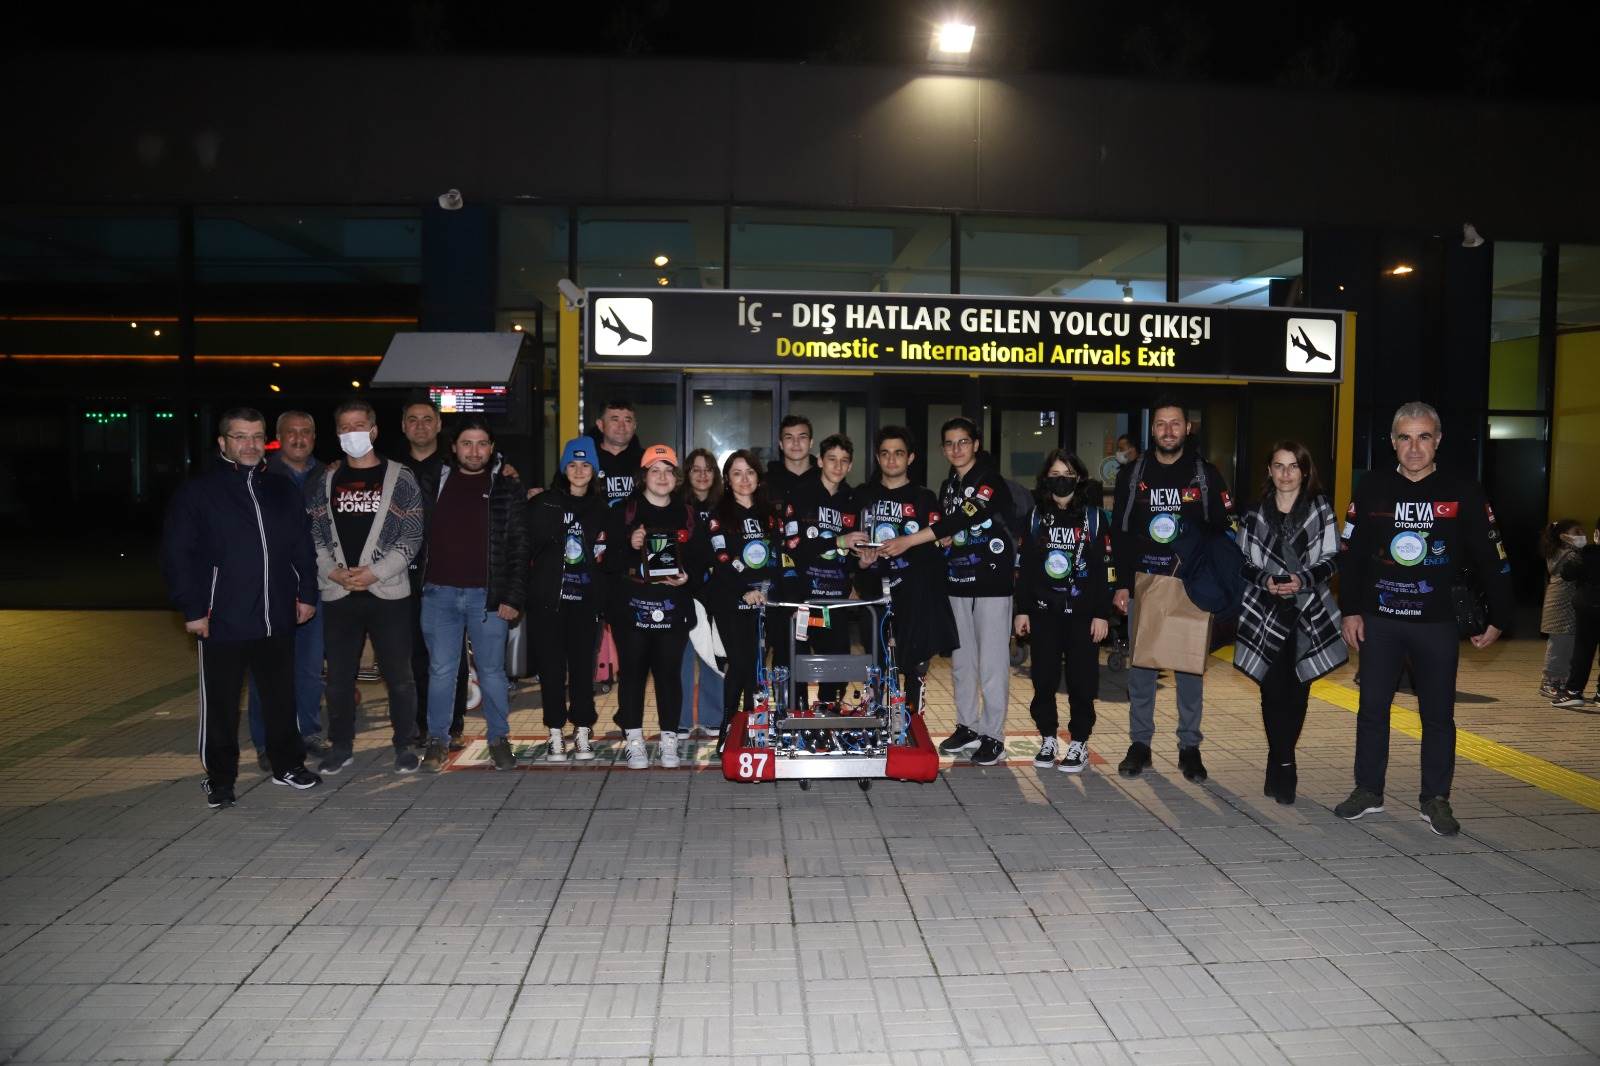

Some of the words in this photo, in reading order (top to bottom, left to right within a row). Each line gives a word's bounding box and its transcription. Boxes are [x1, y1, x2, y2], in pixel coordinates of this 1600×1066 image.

[738, 296, 762, 332] İÇ
[792, 303, 835, 334] DIŞ
[846, 305, 951, 332] HATLAR
[960, 307, 1040, 334] GELEN
[1050, 310, 1131, 337] YOLCU
[1139, 313, 1211, 345] ÇIKIŞI
[776, 337, 879, 360] Domestic
[901, 340, 1044, 363] International
[1051, 343, 1131, 366] Arrivals
[1138, 346, 1175, 368] Exit
[1150, 488, 1181, 505] NEVA
[336, 501, 381, 513] JONES
[818, 506, 842, 527] NEVA
[1394, 502, 1434, 521] NEVA
[1394, 520, 1434, 529] OTOMOTİV
[1048, 527, 1076, 544] NEVA
[738, 752, 768, 778] 87
